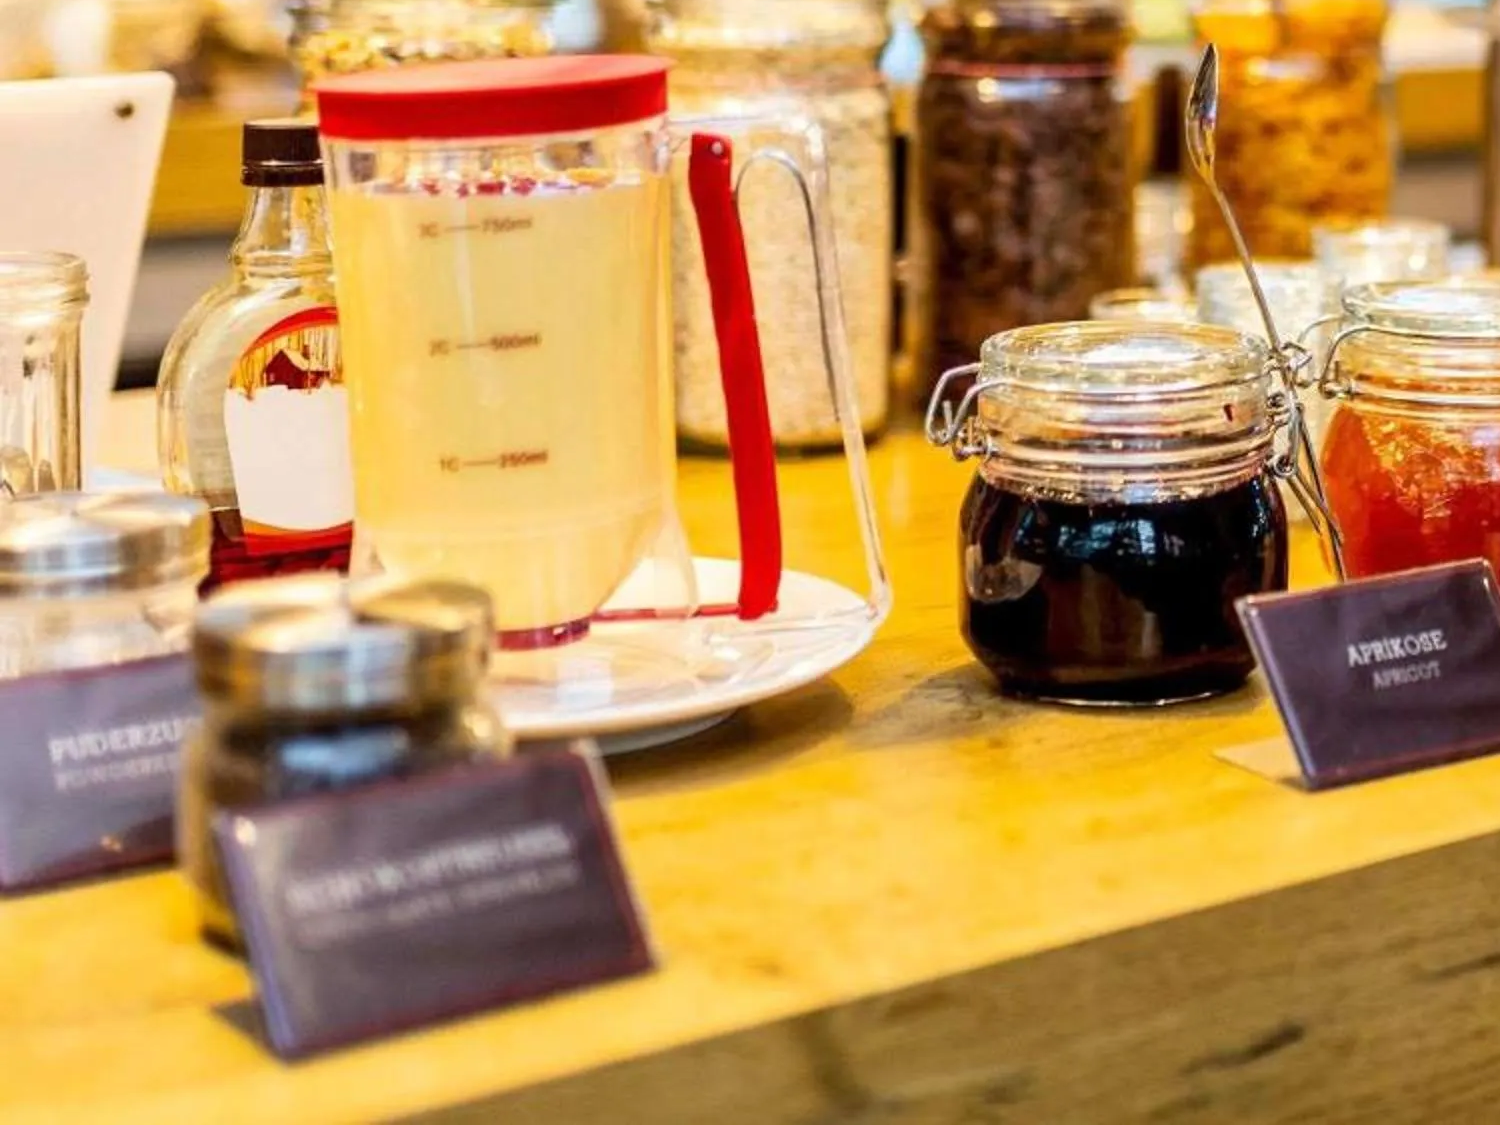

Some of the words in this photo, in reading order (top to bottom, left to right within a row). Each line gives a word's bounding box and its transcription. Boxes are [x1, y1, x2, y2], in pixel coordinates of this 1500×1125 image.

[1347, 629, 1448, 668] APRIKOSE
[1372, 661, 1442, 689] APRICOT
[48, 716, 202, 765] PUDERZU
